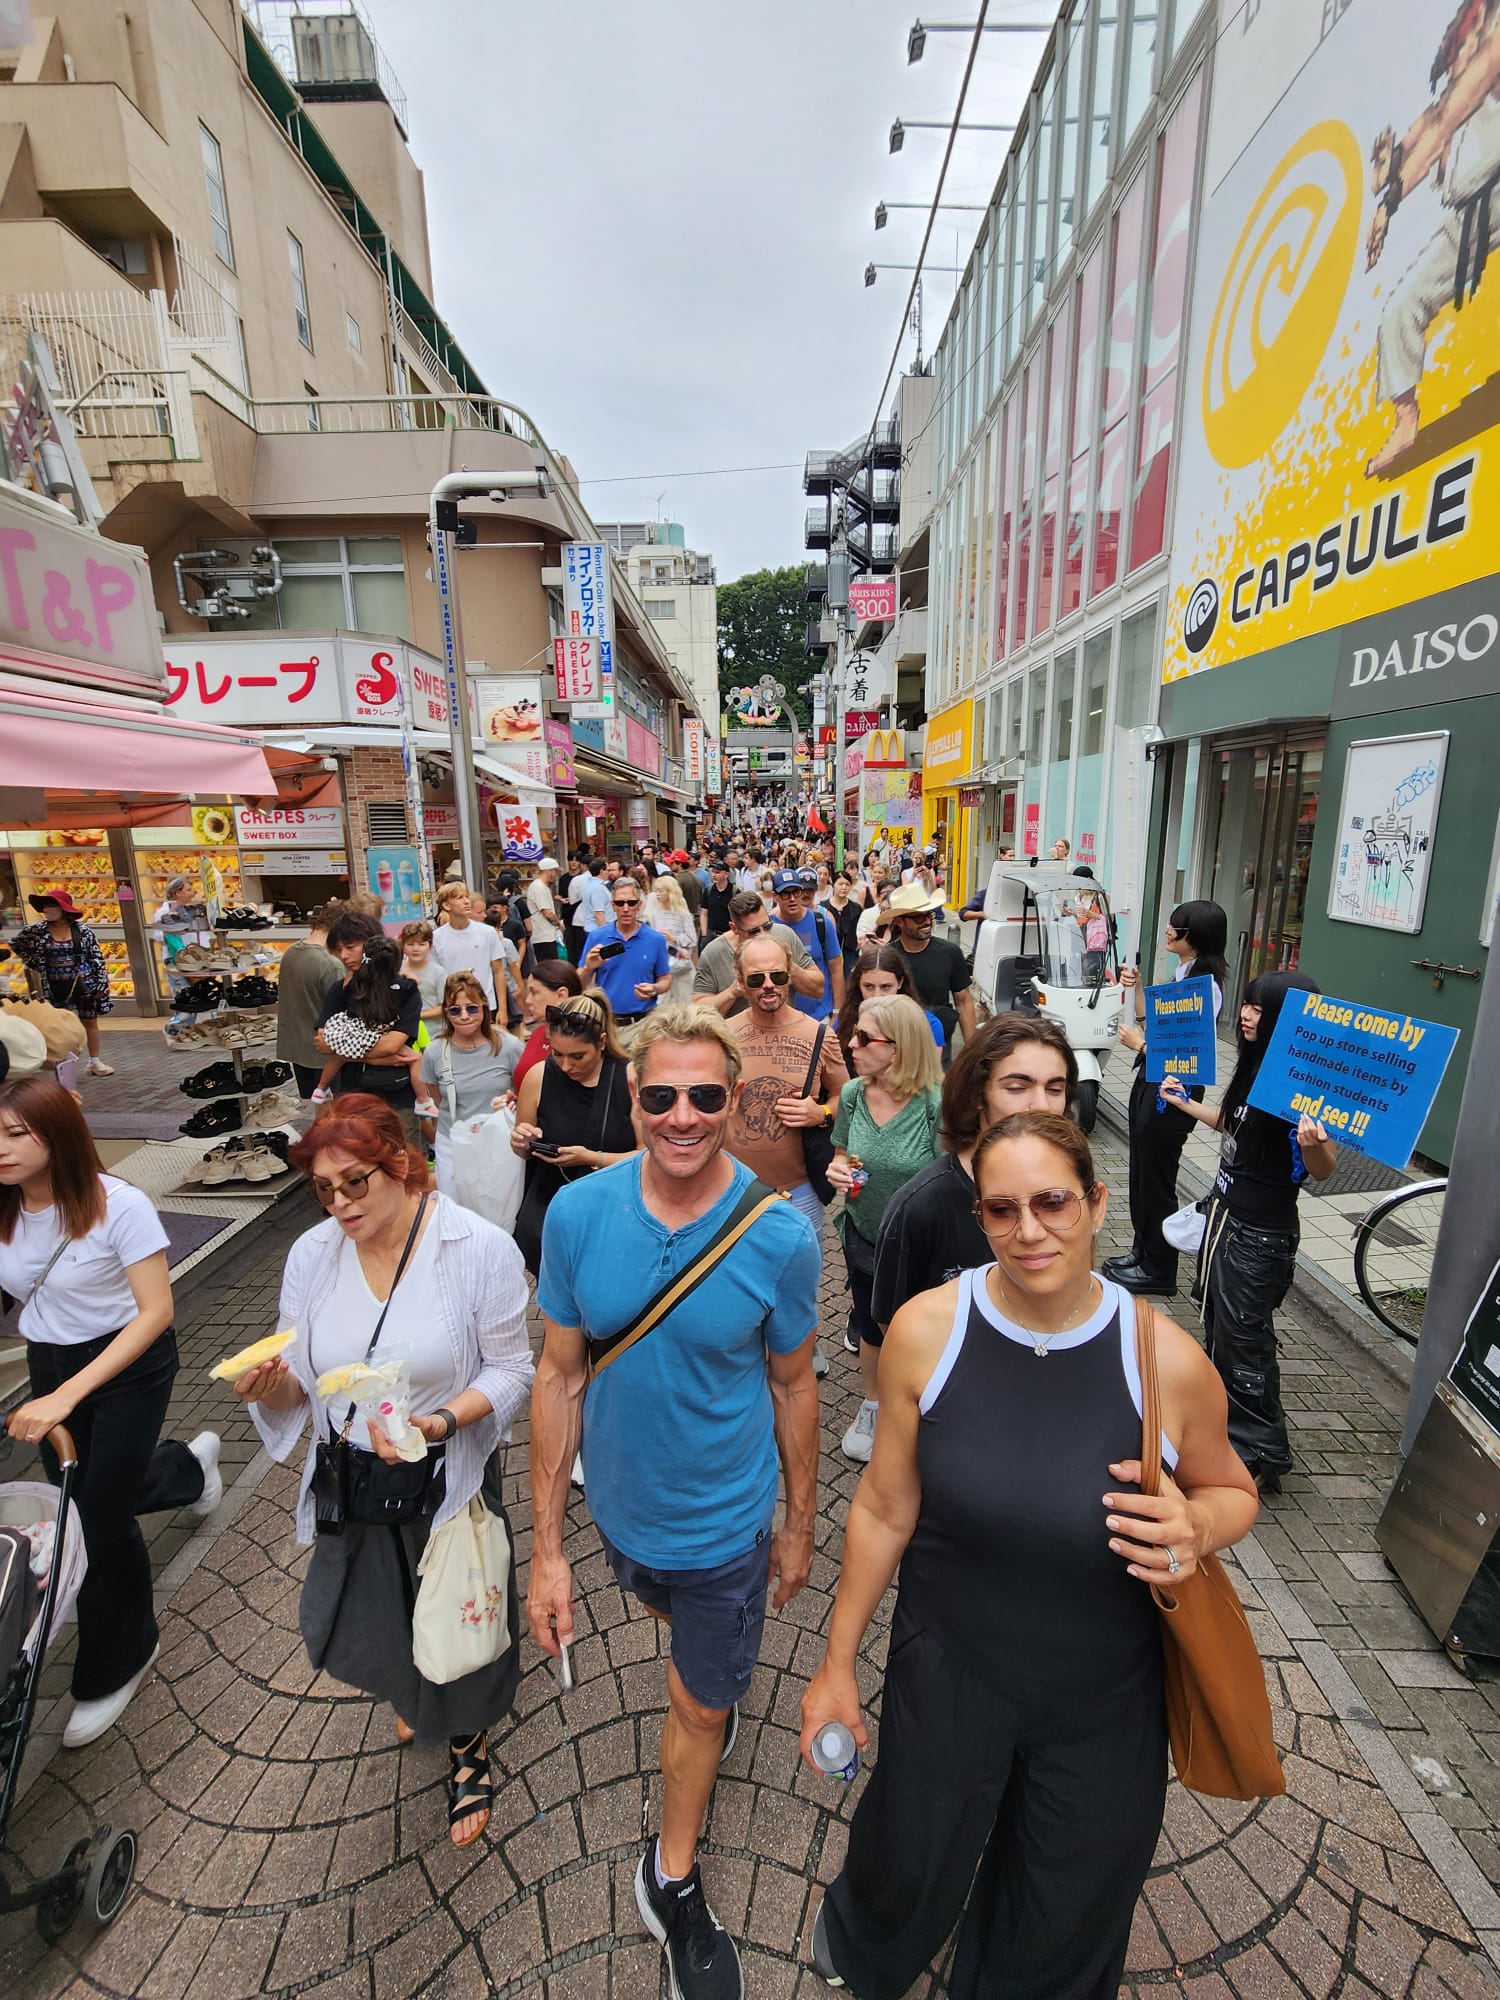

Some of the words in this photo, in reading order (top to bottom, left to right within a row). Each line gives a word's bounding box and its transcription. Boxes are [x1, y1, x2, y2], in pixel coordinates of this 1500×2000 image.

[594, 547, 603, 578] Rental
[1231, 456, 1475, 623] CAPSULE
[578, 547, 594, 636] コインロッカー
[596, 581, 604, 604] Coin
[436, 531, 448, 595] HARAJUKU
[443, 604, 455, 673] TAKESHITA
[449, 682, 459, 727] Street
[597, 606, 606, 640] Locker
[569, 641, 579, 696] CREPES
[579, 641, 593, 696] クレープ
[1350, 614, 1499, 687] DAISO
[163, 656, 319, 706] クレープ
[413, 666, 447, 701] SWEE
[847, 653, 871, 702] 古着
[690, 732, 698, 779] COFFEE
[240, 811, 305, 825] CREPES
[243, 832, 276, 840] SWEET
[278, 832, 297, 840] BOX
[308, 813, 336, 821] クレープ
[504, 815, 533, 844] 氷
[1080, 832, 1095, 849] 原宿
[1154, 998, 1176, 1016] Please
[1176, 998, 1193, 1013] come
[1193, 991, 1203, 1016] by
[1303, 993, 1353, 1026] Please
[1354, 1012, 1399, 1039] come
[1399, 1016, 1426, 1051] by
[1164, 1055, 1177, 1073] and
[1178, 1058, 1190, 1074] see
[1287, 1044, 1350, 1075] handmade
[1351, 1065, 1388, 1088] items
[1390, 1078, 1408, 1096] by
[1295, 1025, 1318, 1043] Pop
[1319, 1035, 1335, 1049] up
[1336, 1040, 1369, 1057] store
[1370, 1050, 1417, 1075] selling
[1287, 1066, 1331, 1090] fashion
[1333, 1084, 1390, 1112] students
[1290, 1092, 1325, 1118] and
[1320, 1104, 1350, 1130] see
